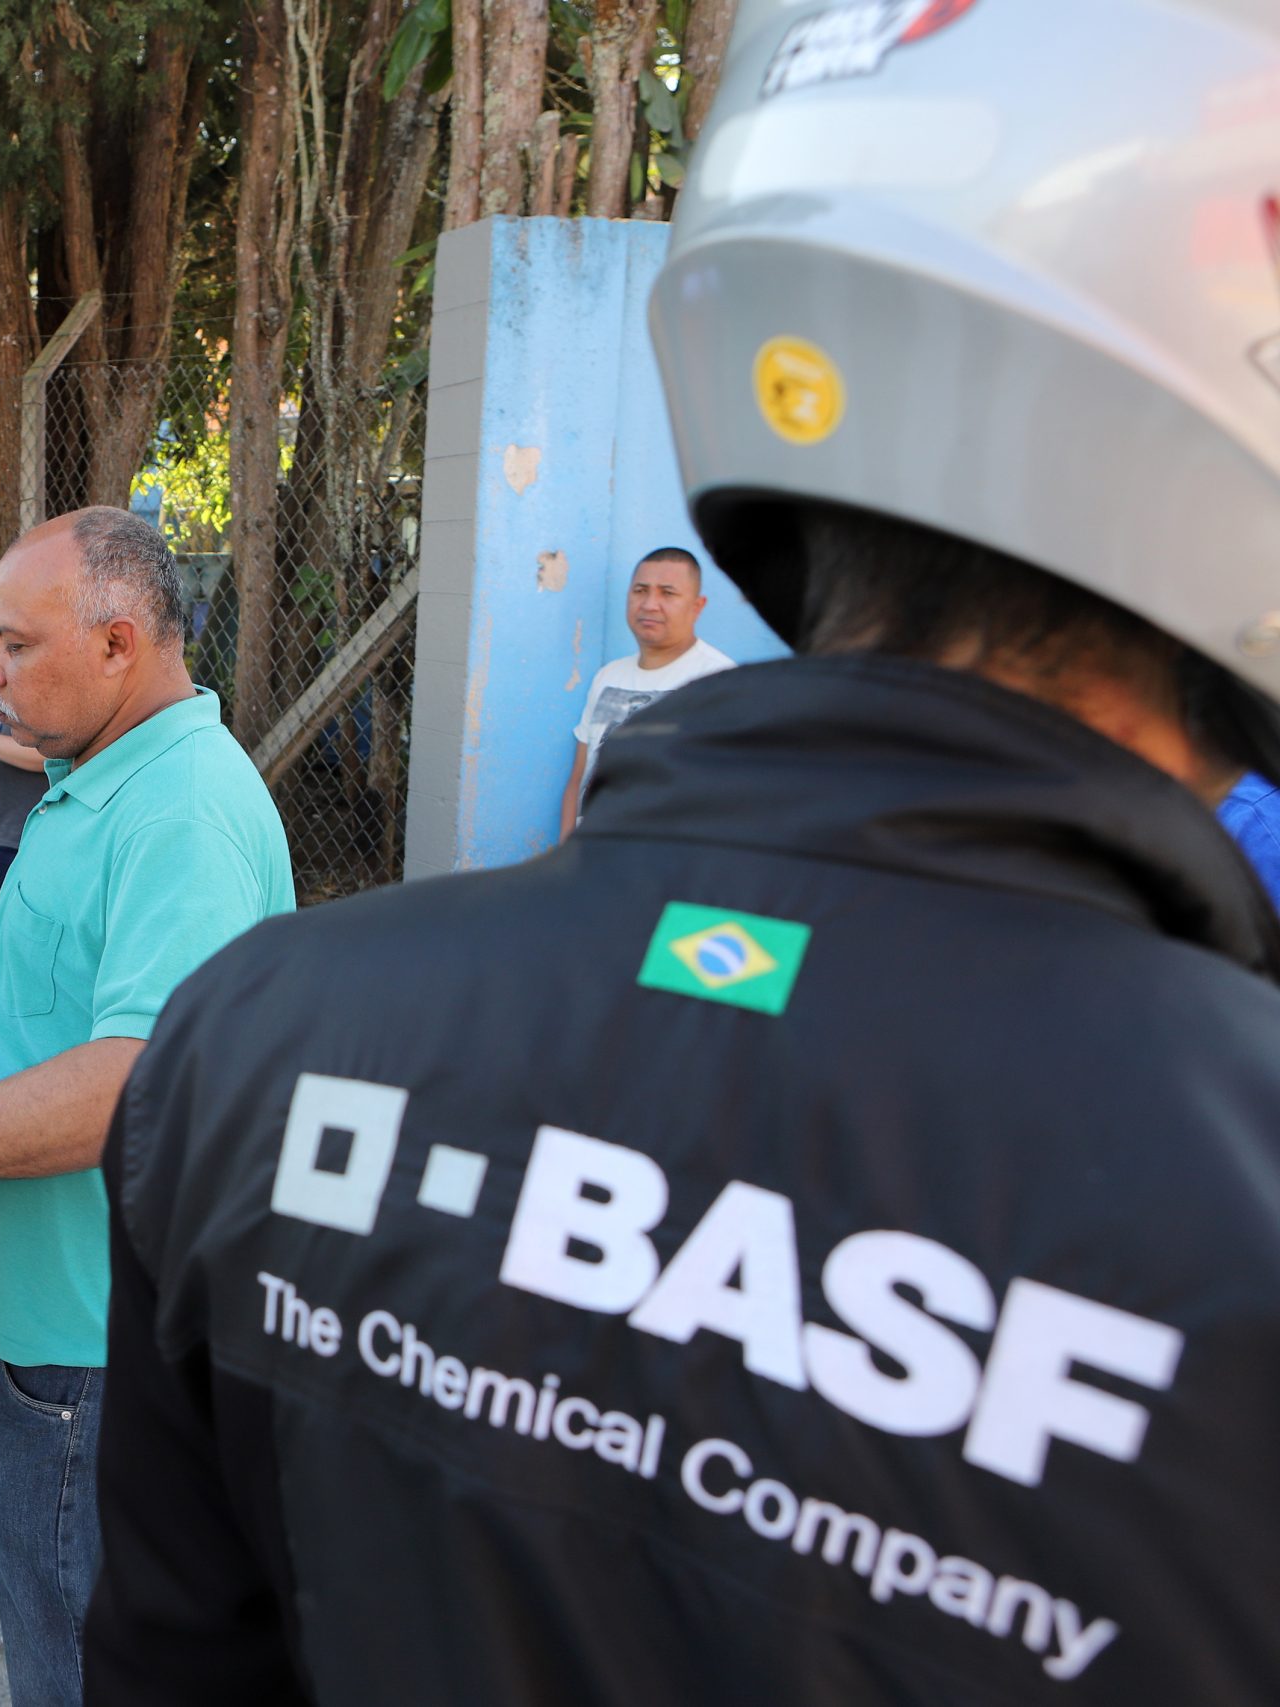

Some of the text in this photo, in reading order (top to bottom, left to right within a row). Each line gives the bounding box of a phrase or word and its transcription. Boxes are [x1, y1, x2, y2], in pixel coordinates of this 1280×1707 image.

[257, 1271, 1121, 1681] The Chemical Company
[499, 1124, 1185, 1488] BASF
